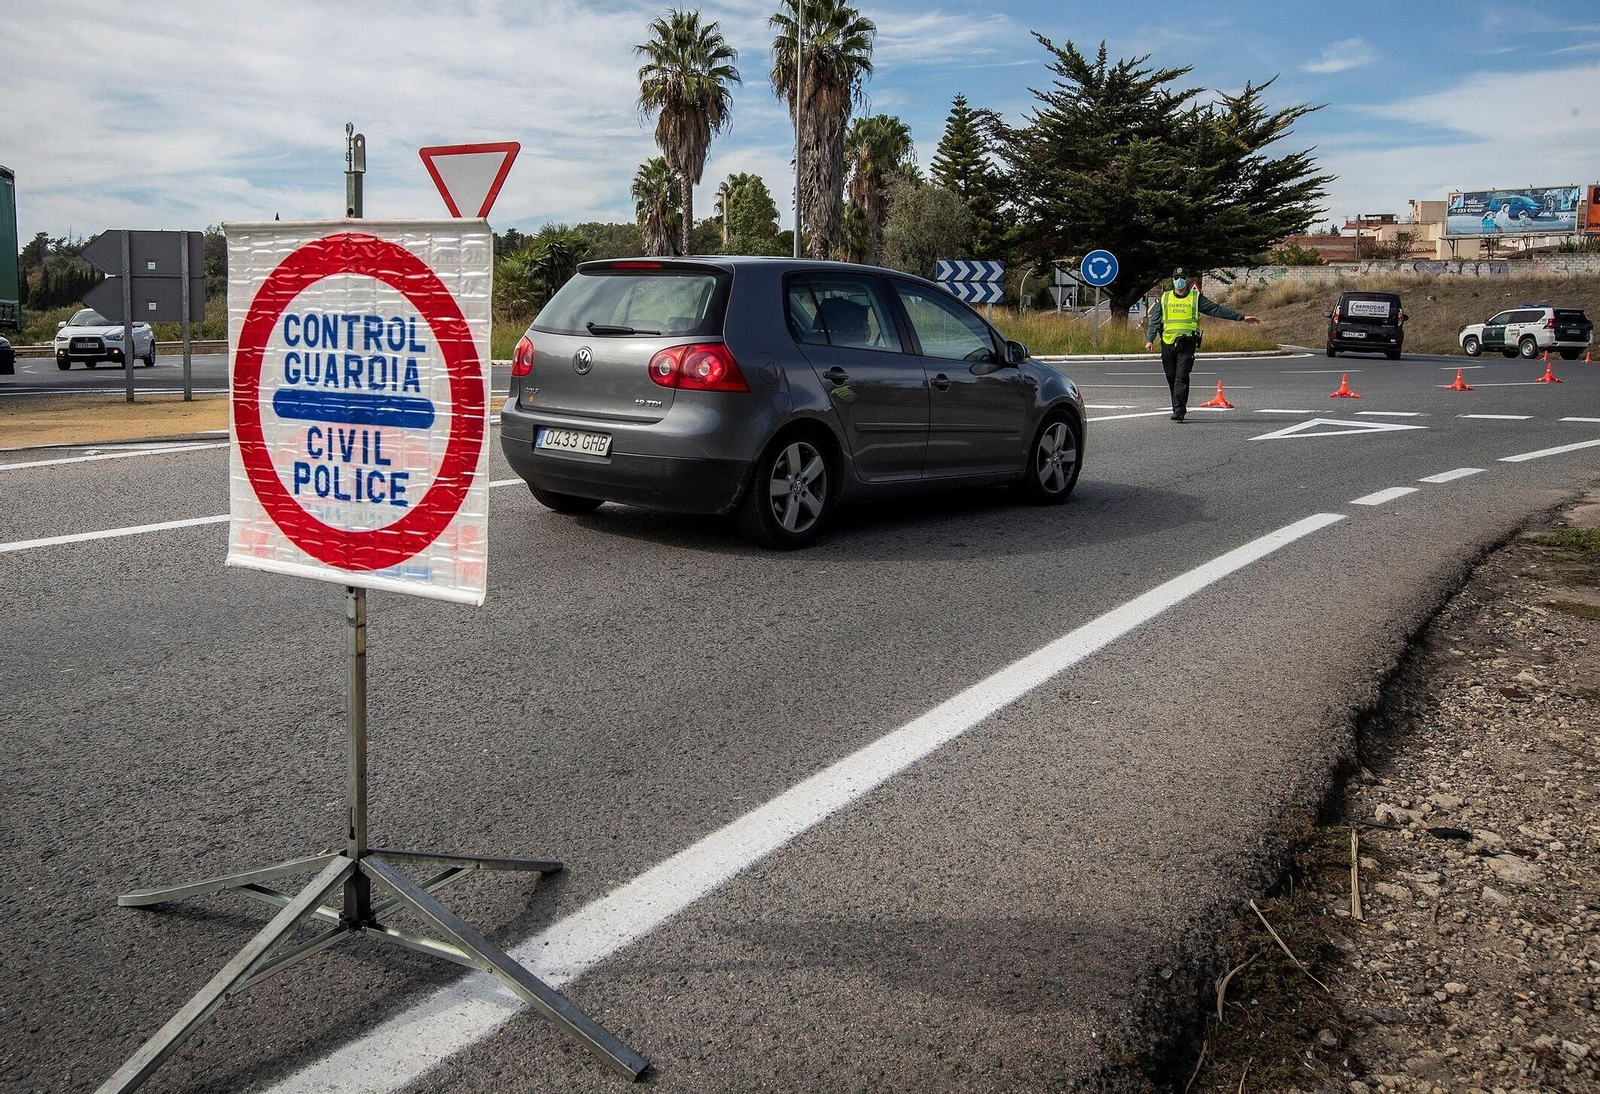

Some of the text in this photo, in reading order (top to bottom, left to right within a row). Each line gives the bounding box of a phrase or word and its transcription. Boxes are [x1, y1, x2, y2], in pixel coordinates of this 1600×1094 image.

[283, 314, 426, 352] CONTROL
[284, 352, 421, 393] GUARDIA
[307, 426, 391, 466] CIVIL
[545, 430, 608, 452] 0433 GHB
[294, 461, 409, 508] POLICE
